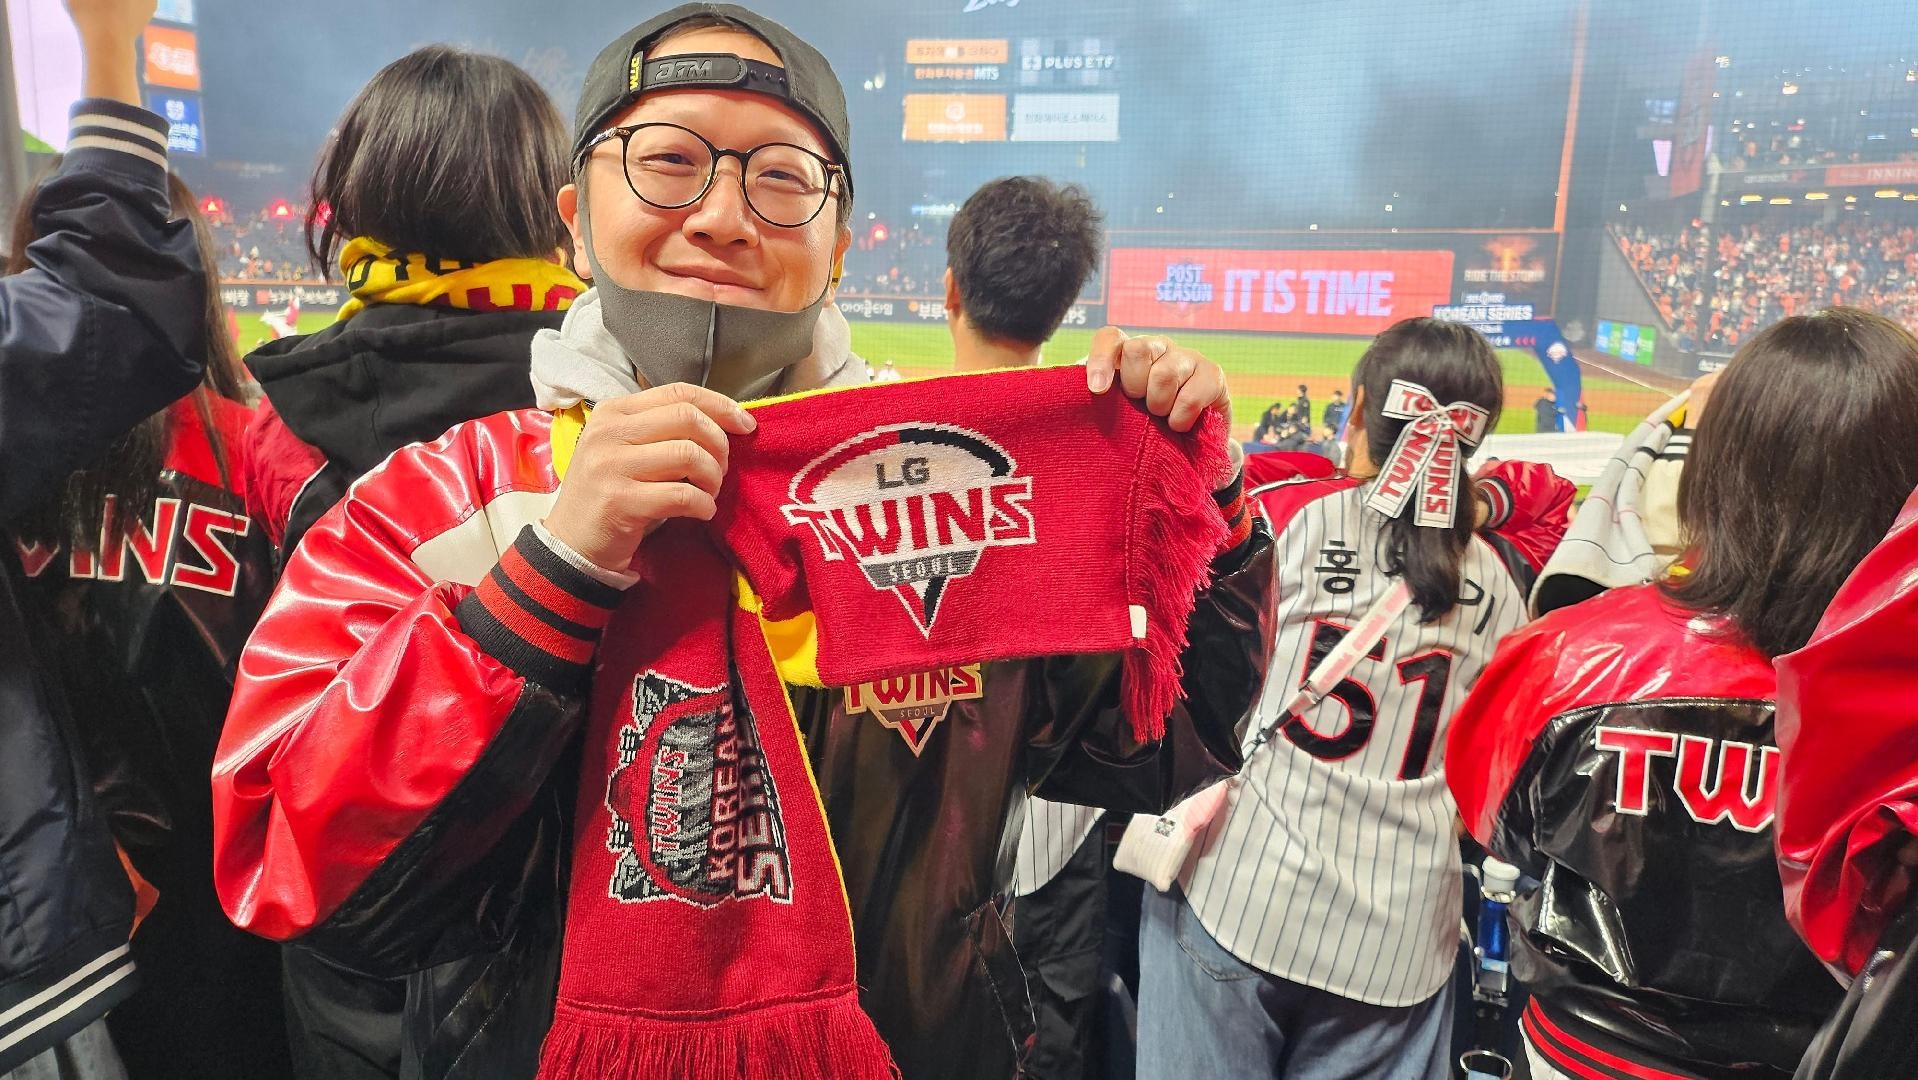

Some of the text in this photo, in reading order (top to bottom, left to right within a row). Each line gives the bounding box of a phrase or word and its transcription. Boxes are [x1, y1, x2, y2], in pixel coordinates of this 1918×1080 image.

[1045, 56, 1114, 69] PLUS ETF
[1167, 264, 1204, 283] POST
[1156, 283, 1212, 302] SEASON
[1224, 269, 1395, 317] IT IS TIME
[1433, 305, 1533, 321] KOREAN SERIES
[876, 456, 931, 490] LG
[780, 475, 1036, 562] TWINS
[888, 557, 957, 582] SEOUL
[1281, 618, 1453, 781] 51
[651, 745, 690, 853] TWINS
